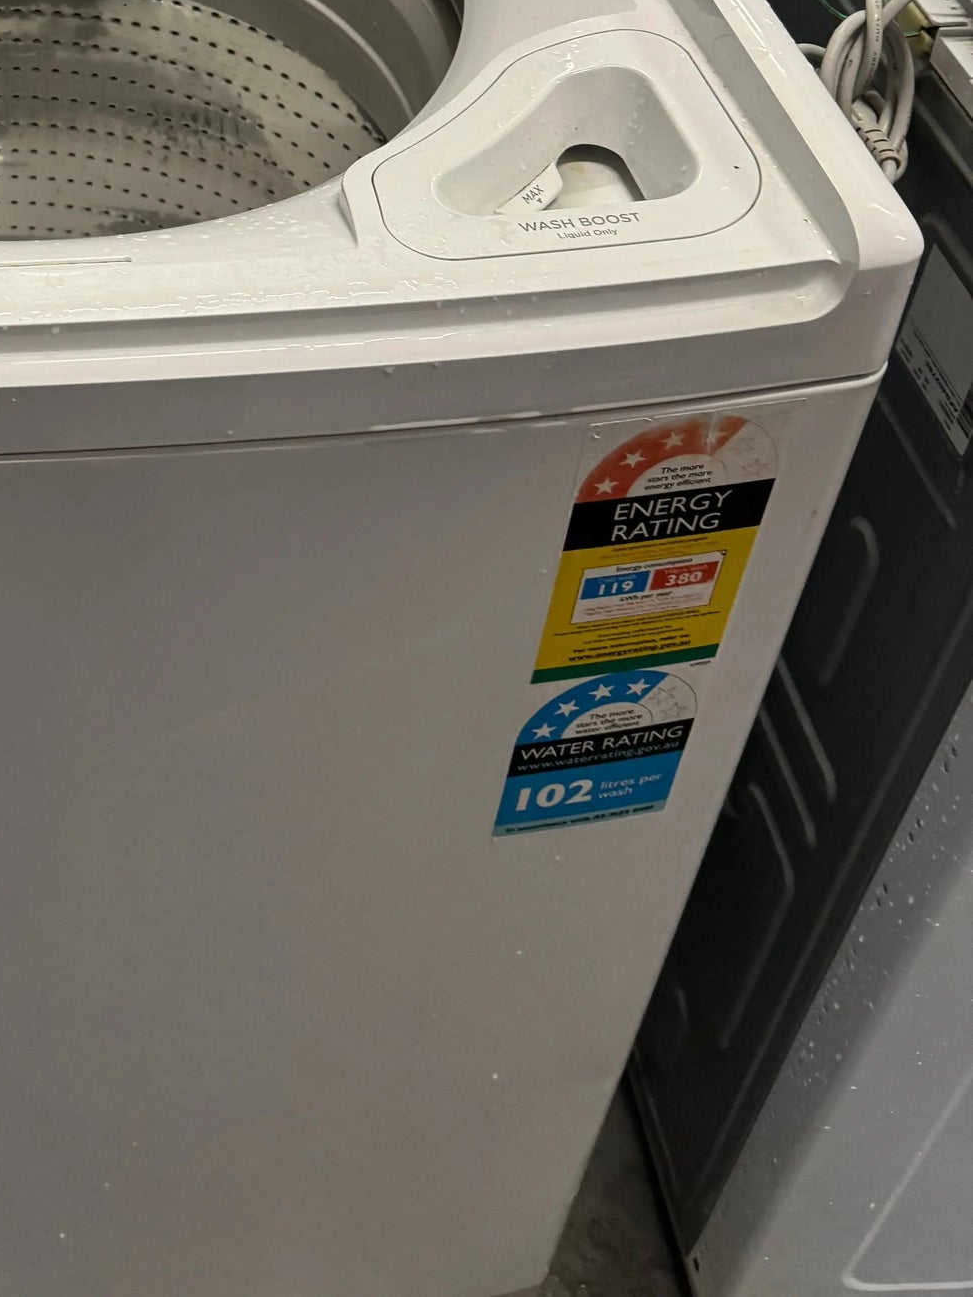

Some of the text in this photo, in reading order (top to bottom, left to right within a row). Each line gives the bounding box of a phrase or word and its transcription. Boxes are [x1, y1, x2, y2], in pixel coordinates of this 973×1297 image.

[522, 184, 544, 204] MAX
[518, 212, 640, 232] WASH BOOST
[557, 228, 618, 240] Liquid Only
[644, 477, 711, 491] energy efficient
[671, 472, 686, 480] the
[688, 470, 713, 478] more
[613, 489, 733, 520] ENERGY
[611, 512, 721, 541] RATING
[599, 571, 703, 595] 119 380
[600, 718, 616, 726] the
[618, 714, 643, 722] more
[521, 725, 684, 760] WATER RATING
[517, 741, 679, 771] www.waterrating.gov.au
[515, 773, 663, 812] 102 litres per
[598, 788, 633, 799] wash
